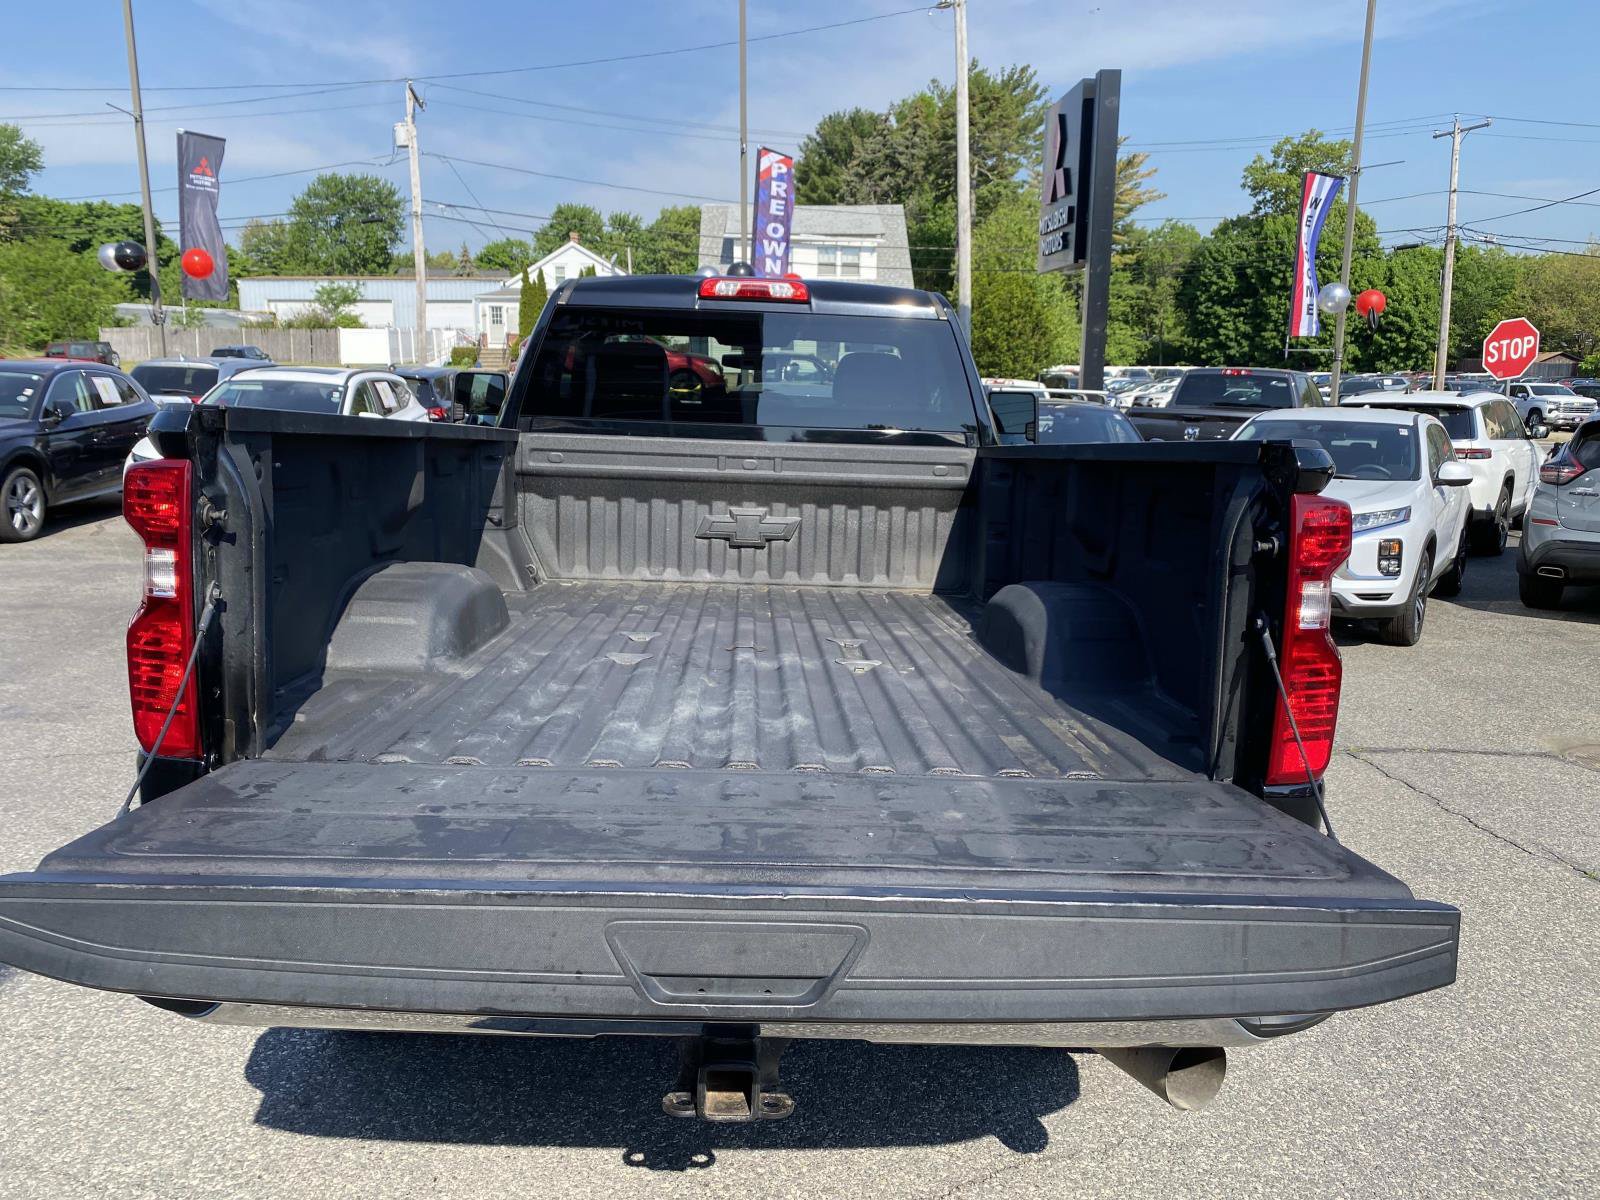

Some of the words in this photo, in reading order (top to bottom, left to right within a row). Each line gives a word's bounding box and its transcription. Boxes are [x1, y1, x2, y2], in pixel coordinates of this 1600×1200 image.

[769, 162, 788, 216] PRE
[762, 222, 787, 278] OWN
[1040, 231, 1063, 256] MOTORS
[1487, 335, 1535, 363] STOP
